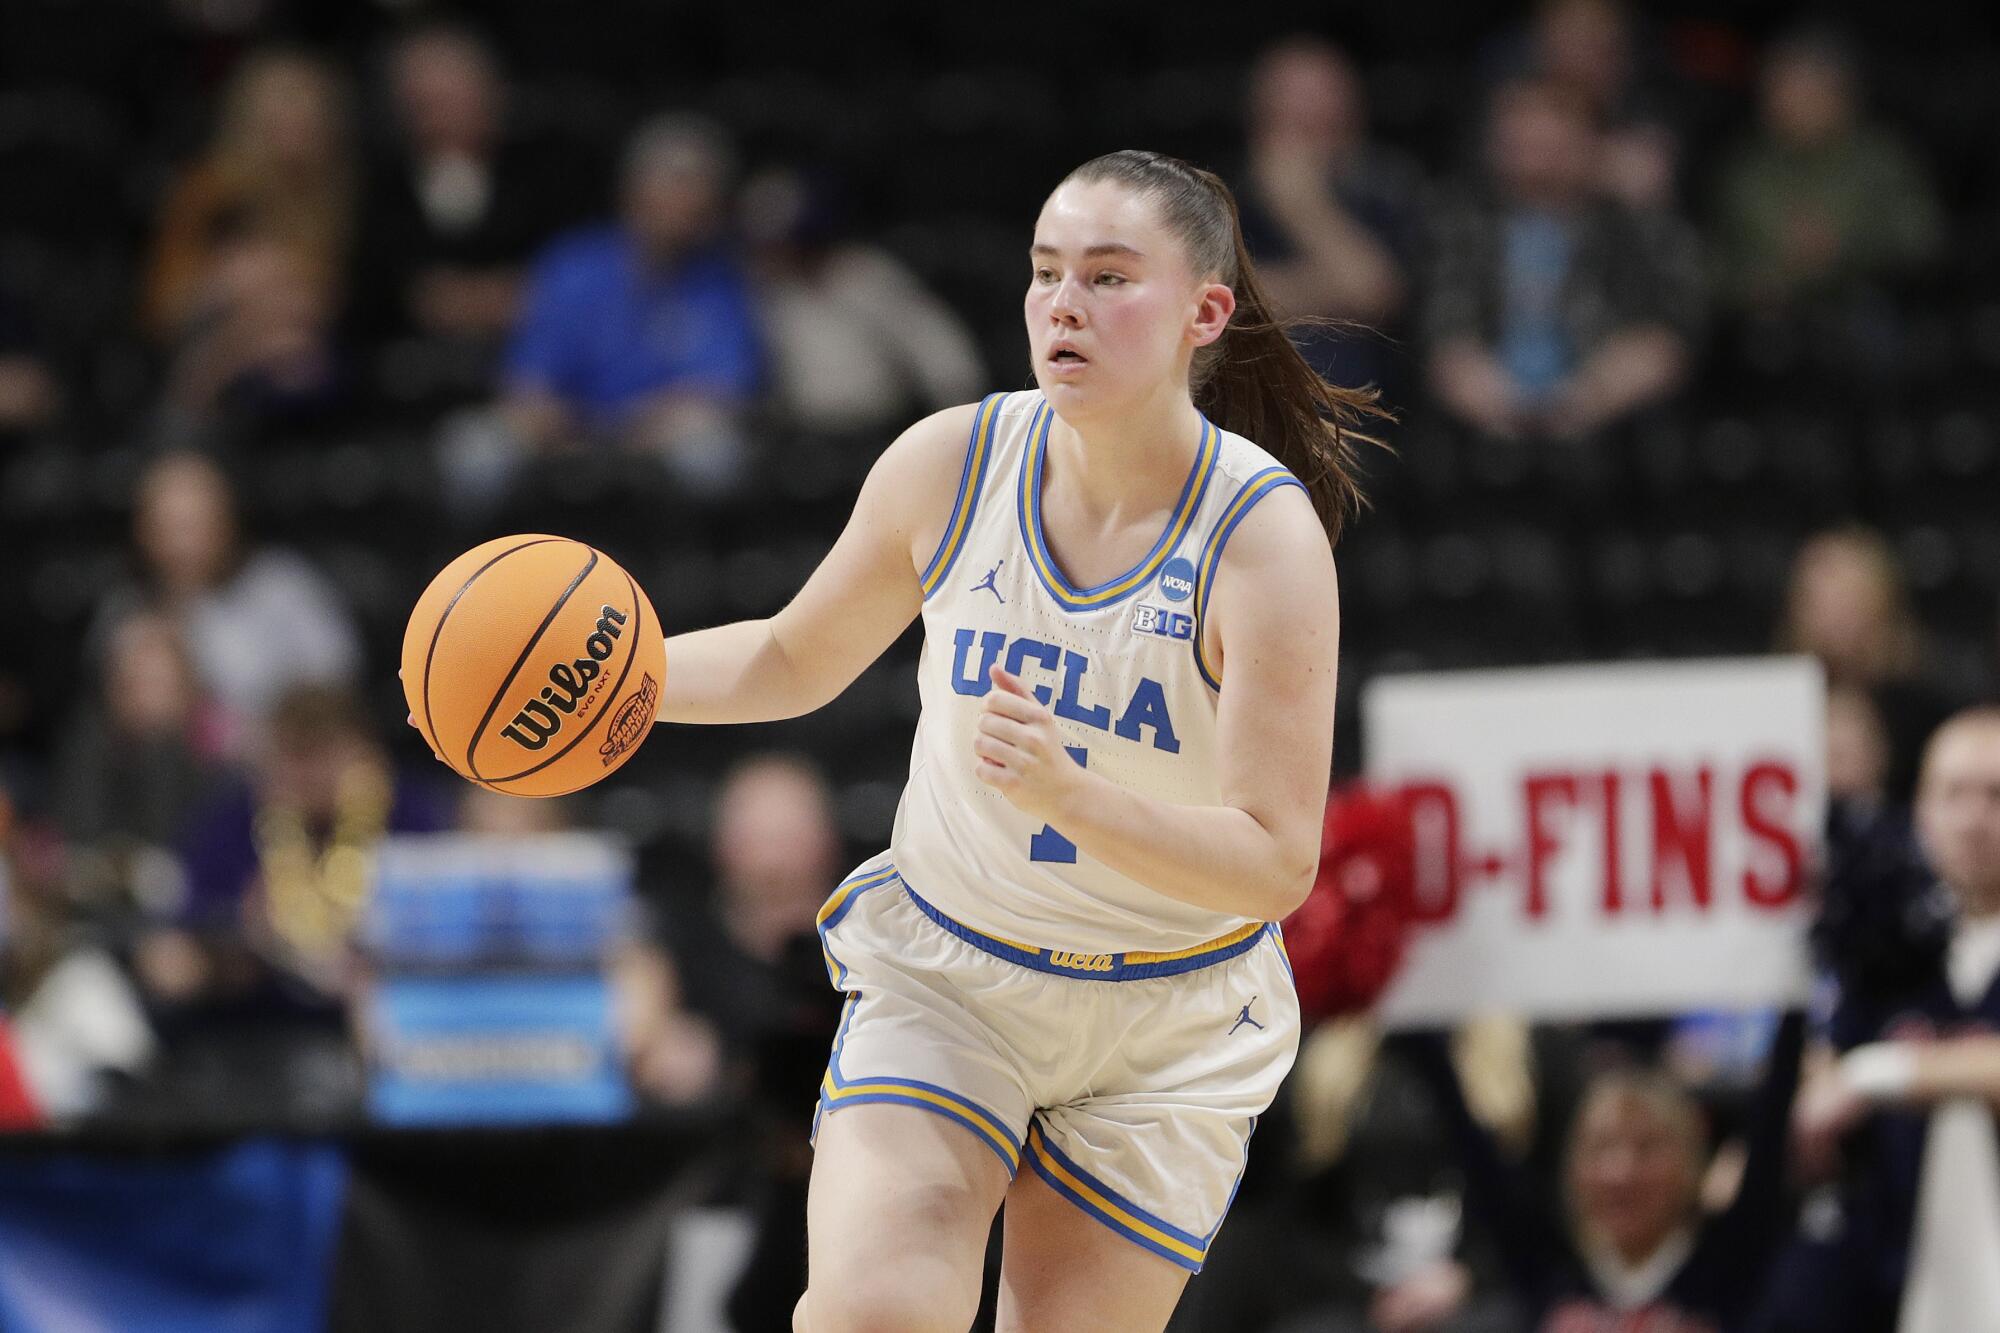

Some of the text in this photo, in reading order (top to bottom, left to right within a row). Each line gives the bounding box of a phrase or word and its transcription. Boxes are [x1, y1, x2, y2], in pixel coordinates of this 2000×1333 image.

[1162, 574, 1192, 594] NCAA
[500, 604, 628, 751] Wilson
[577, 669, 611, 718] EVO NXT
[951, 627, 1180, 754] UCLA
[612, 698, 644, 745] MARCH
